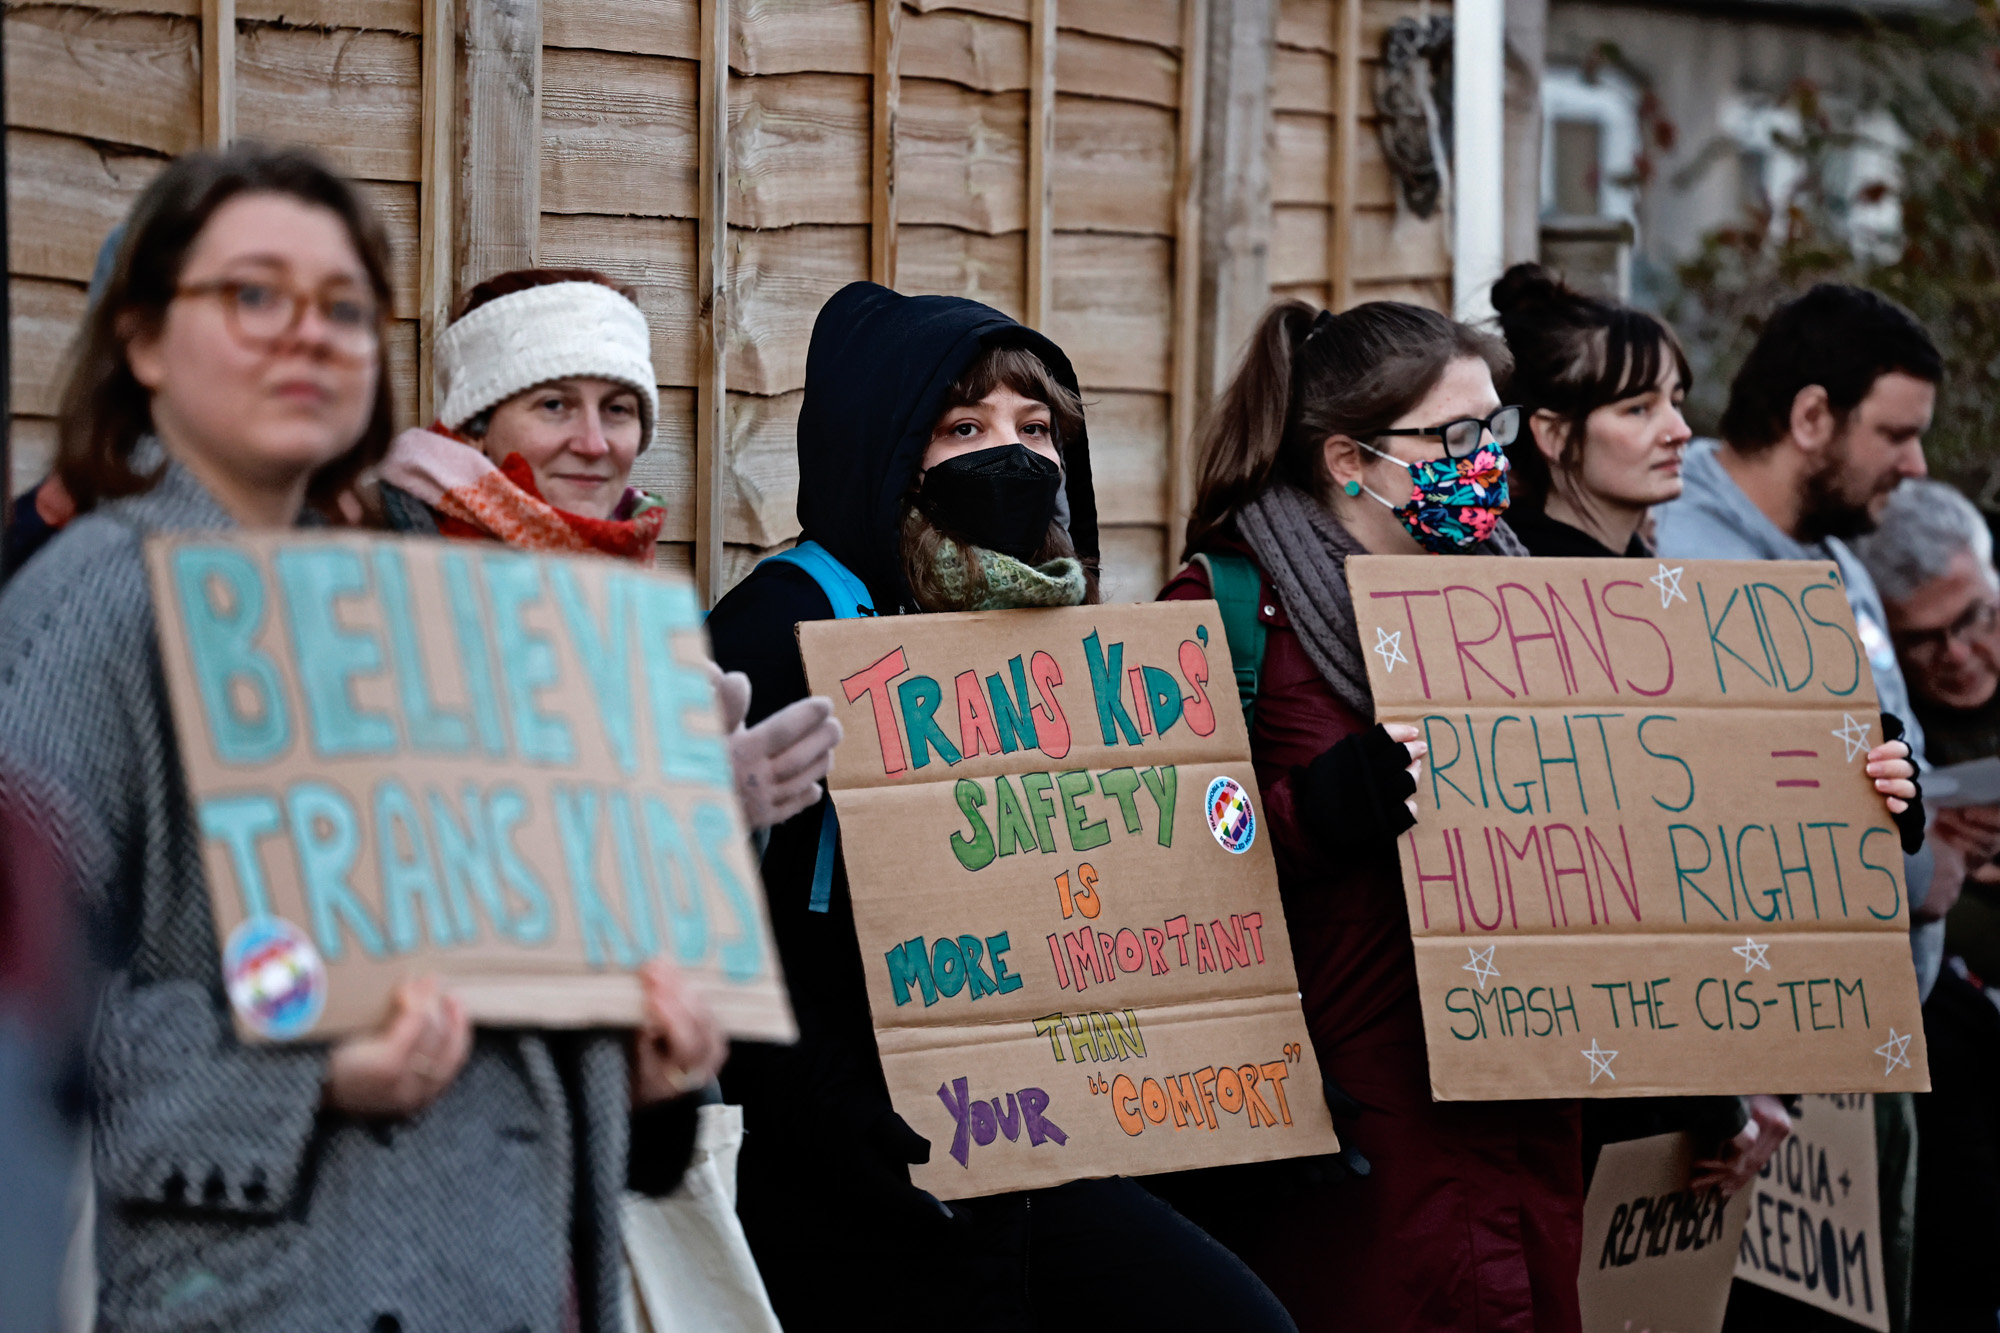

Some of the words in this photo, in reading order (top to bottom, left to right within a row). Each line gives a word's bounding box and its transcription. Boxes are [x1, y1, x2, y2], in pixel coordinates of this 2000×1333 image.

[172, 545, 732, 786] BELIEVE
[1370, 578, 1674, 700] TRANS
[1697, 570, 1860, 695] KIDS'
[840, 645, 1071, 777] TRANS
[1423, 713, 1695, 815] RIGHTS
[1771, 750, 1820, 787] =
[950, 765, 1178, 871] SAFETY
[200, 780, 554, 960] TRANS
[554, 788, 763, 983] KIDS
[1054, 862, 1100, 919] IS
[1409, 823, 1642, 933] HUMAN
[1667, 822, 1901, 923] RIGHTS
[884, 931, 1024, 1007] MORE
[1046, 912, 1265, 993] IMPORTANT
[1033, 1009, 1148, 1064] THAN
[1444, 985, 1580, 1041] SMASH
[1592, 977, 1678, 1030] THE
[1696, 977, 1870, 1032] CIS-TEM
[937, 1076, 1070, 1169] YOUR
[1757, 1134, 1853, 1206] QIA+
[1599, 1185, 1732, 1270] REMEMBER
